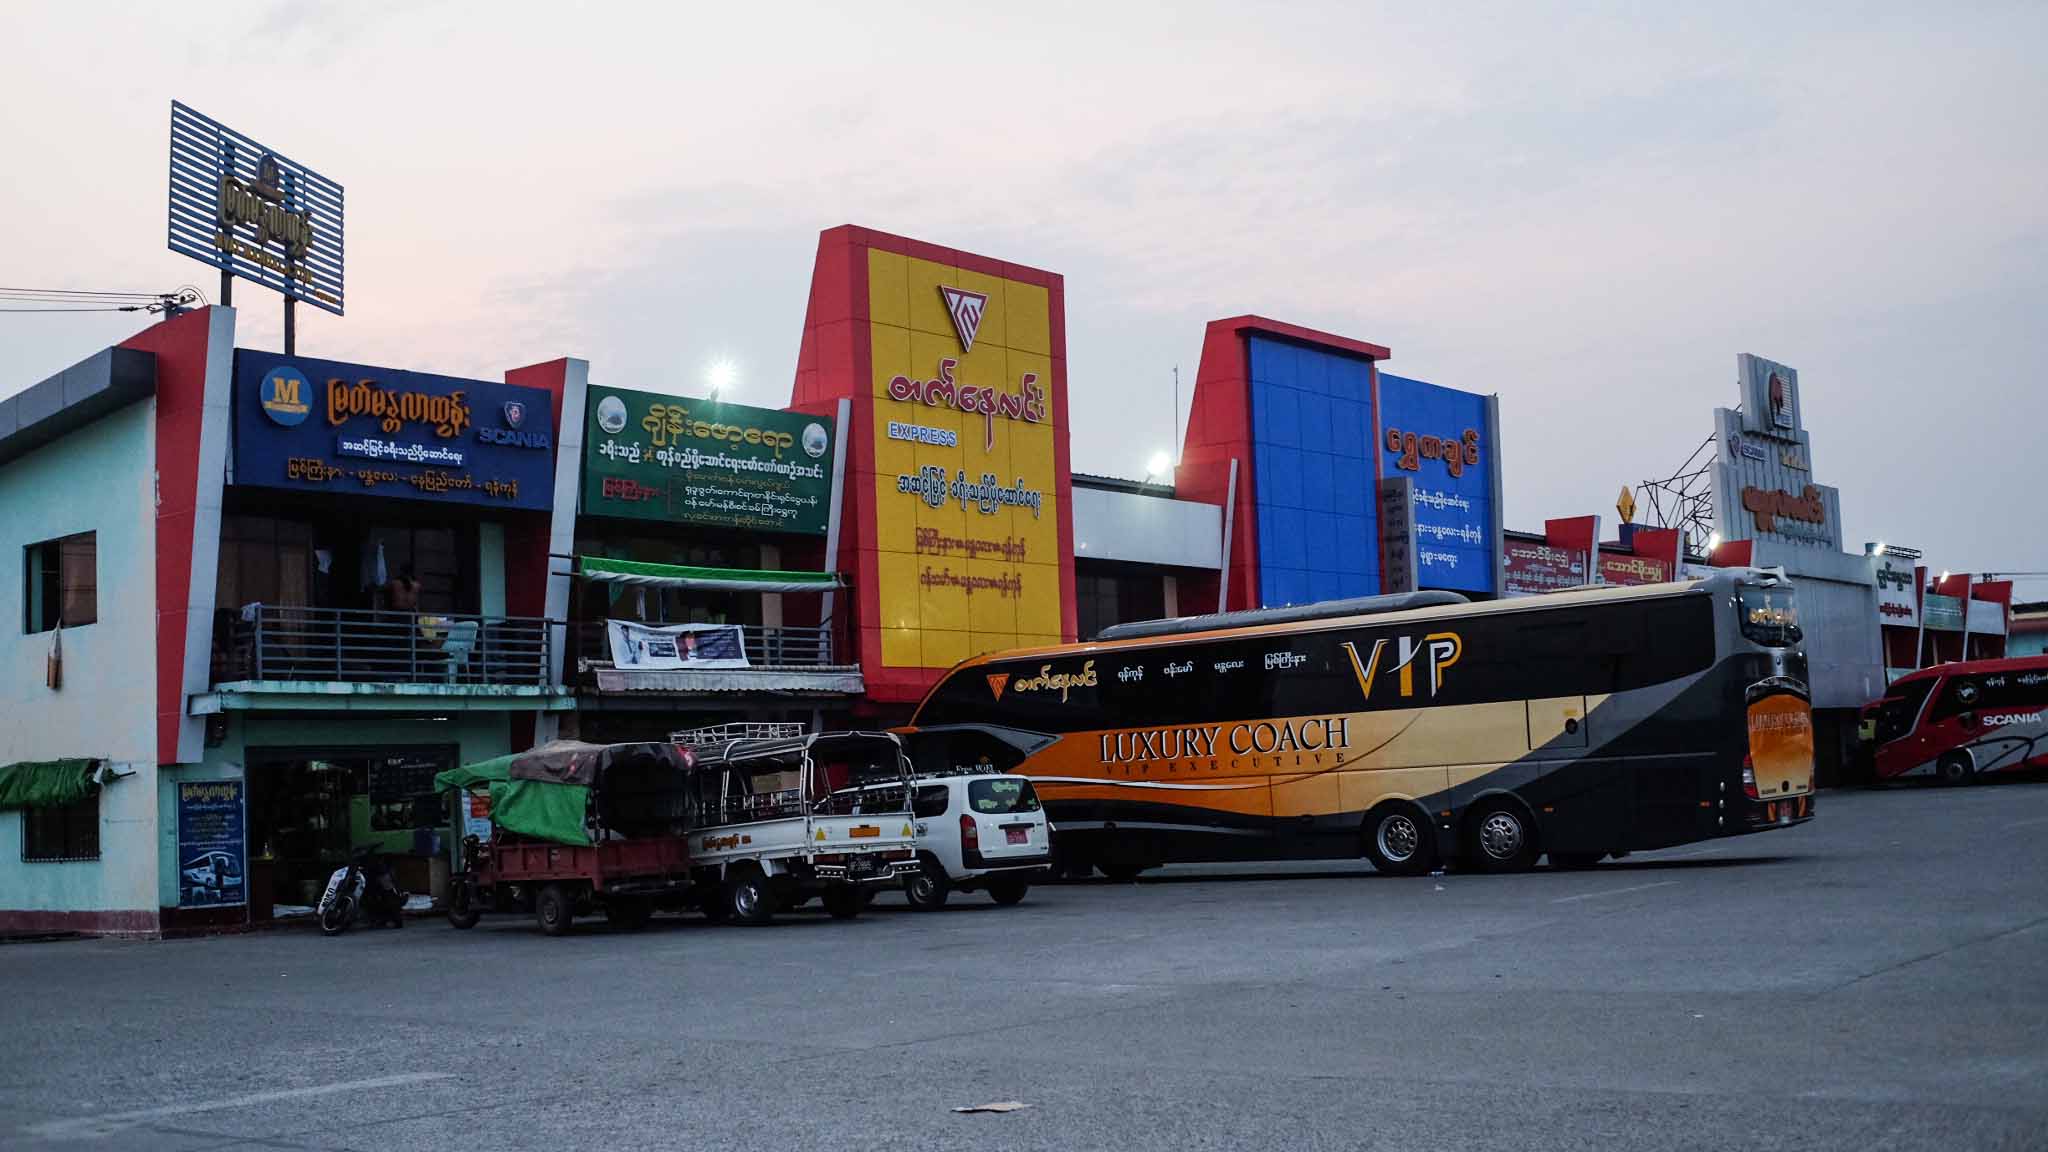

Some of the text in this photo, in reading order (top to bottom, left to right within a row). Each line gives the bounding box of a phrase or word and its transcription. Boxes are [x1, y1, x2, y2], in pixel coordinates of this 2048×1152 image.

[272, 377, 301, 404] M
[887, 358, 1047, 451] တက်နေလင်း
[479, 427, 549, 450] SCANIA
[889, 421, 958, 447] EXPRESS
[1338, 631, 1462, 700] VIP
[1013, 660, 1098, 703] တက်နေလင်း
[1983, 712, 2042, 727] SCANIA
[1099, 717, 1351, 764] LUXURY COACH
[1106, 753, 1345, 776] VIP EXECUTIVE
